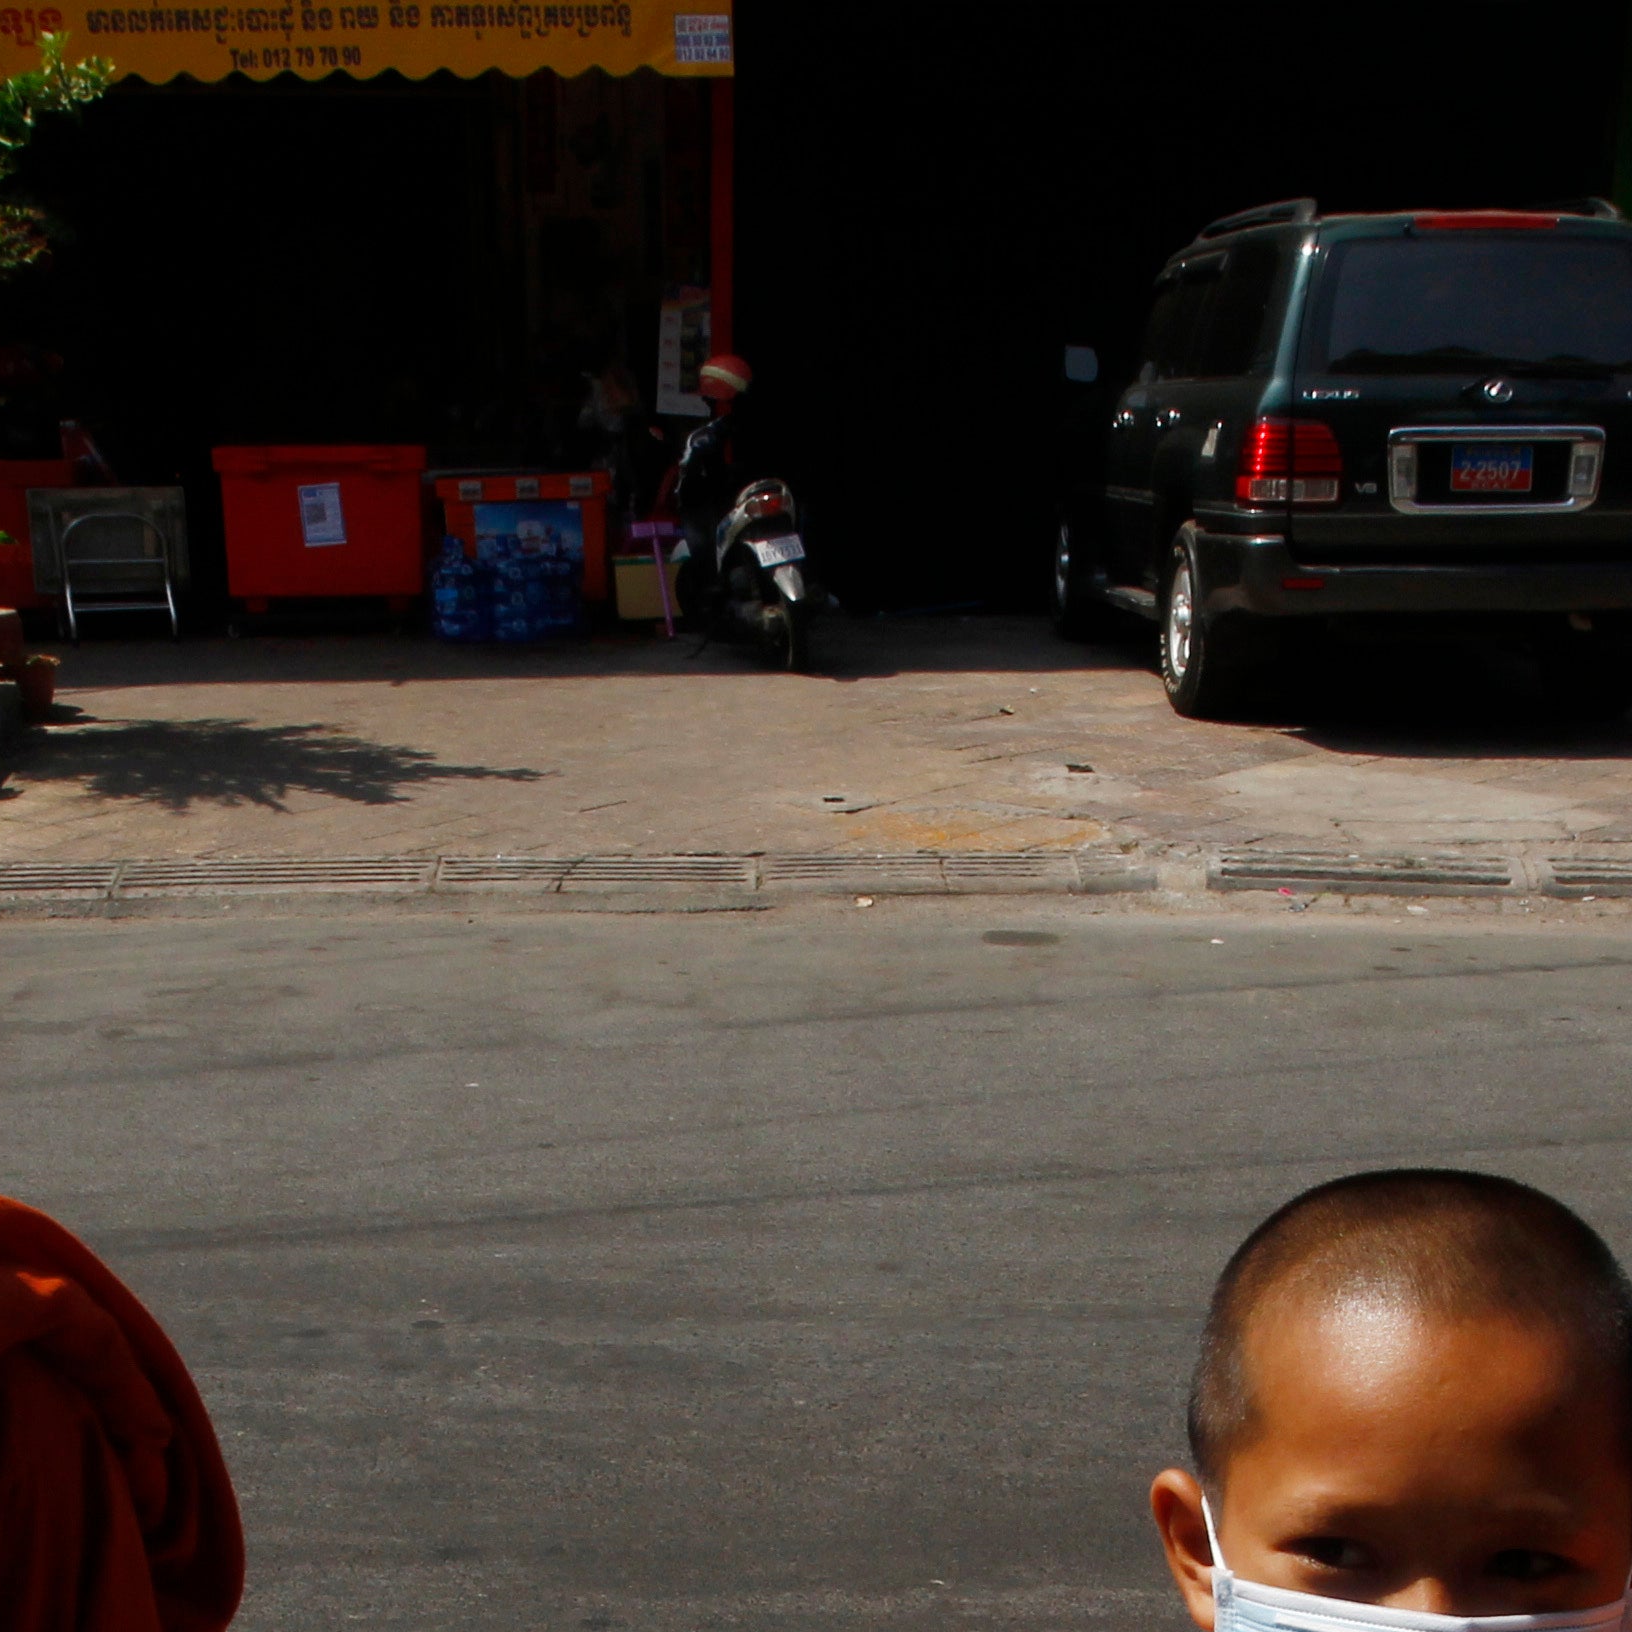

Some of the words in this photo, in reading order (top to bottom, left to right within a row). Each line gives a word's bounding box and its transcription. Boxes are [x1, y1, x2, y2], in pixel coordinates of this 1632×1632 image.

[230, 48, 258, 69] Tel:
[1301, 389, 1360, 400] LEXUS
[1459, 460, 1522, 481] 2-2507
